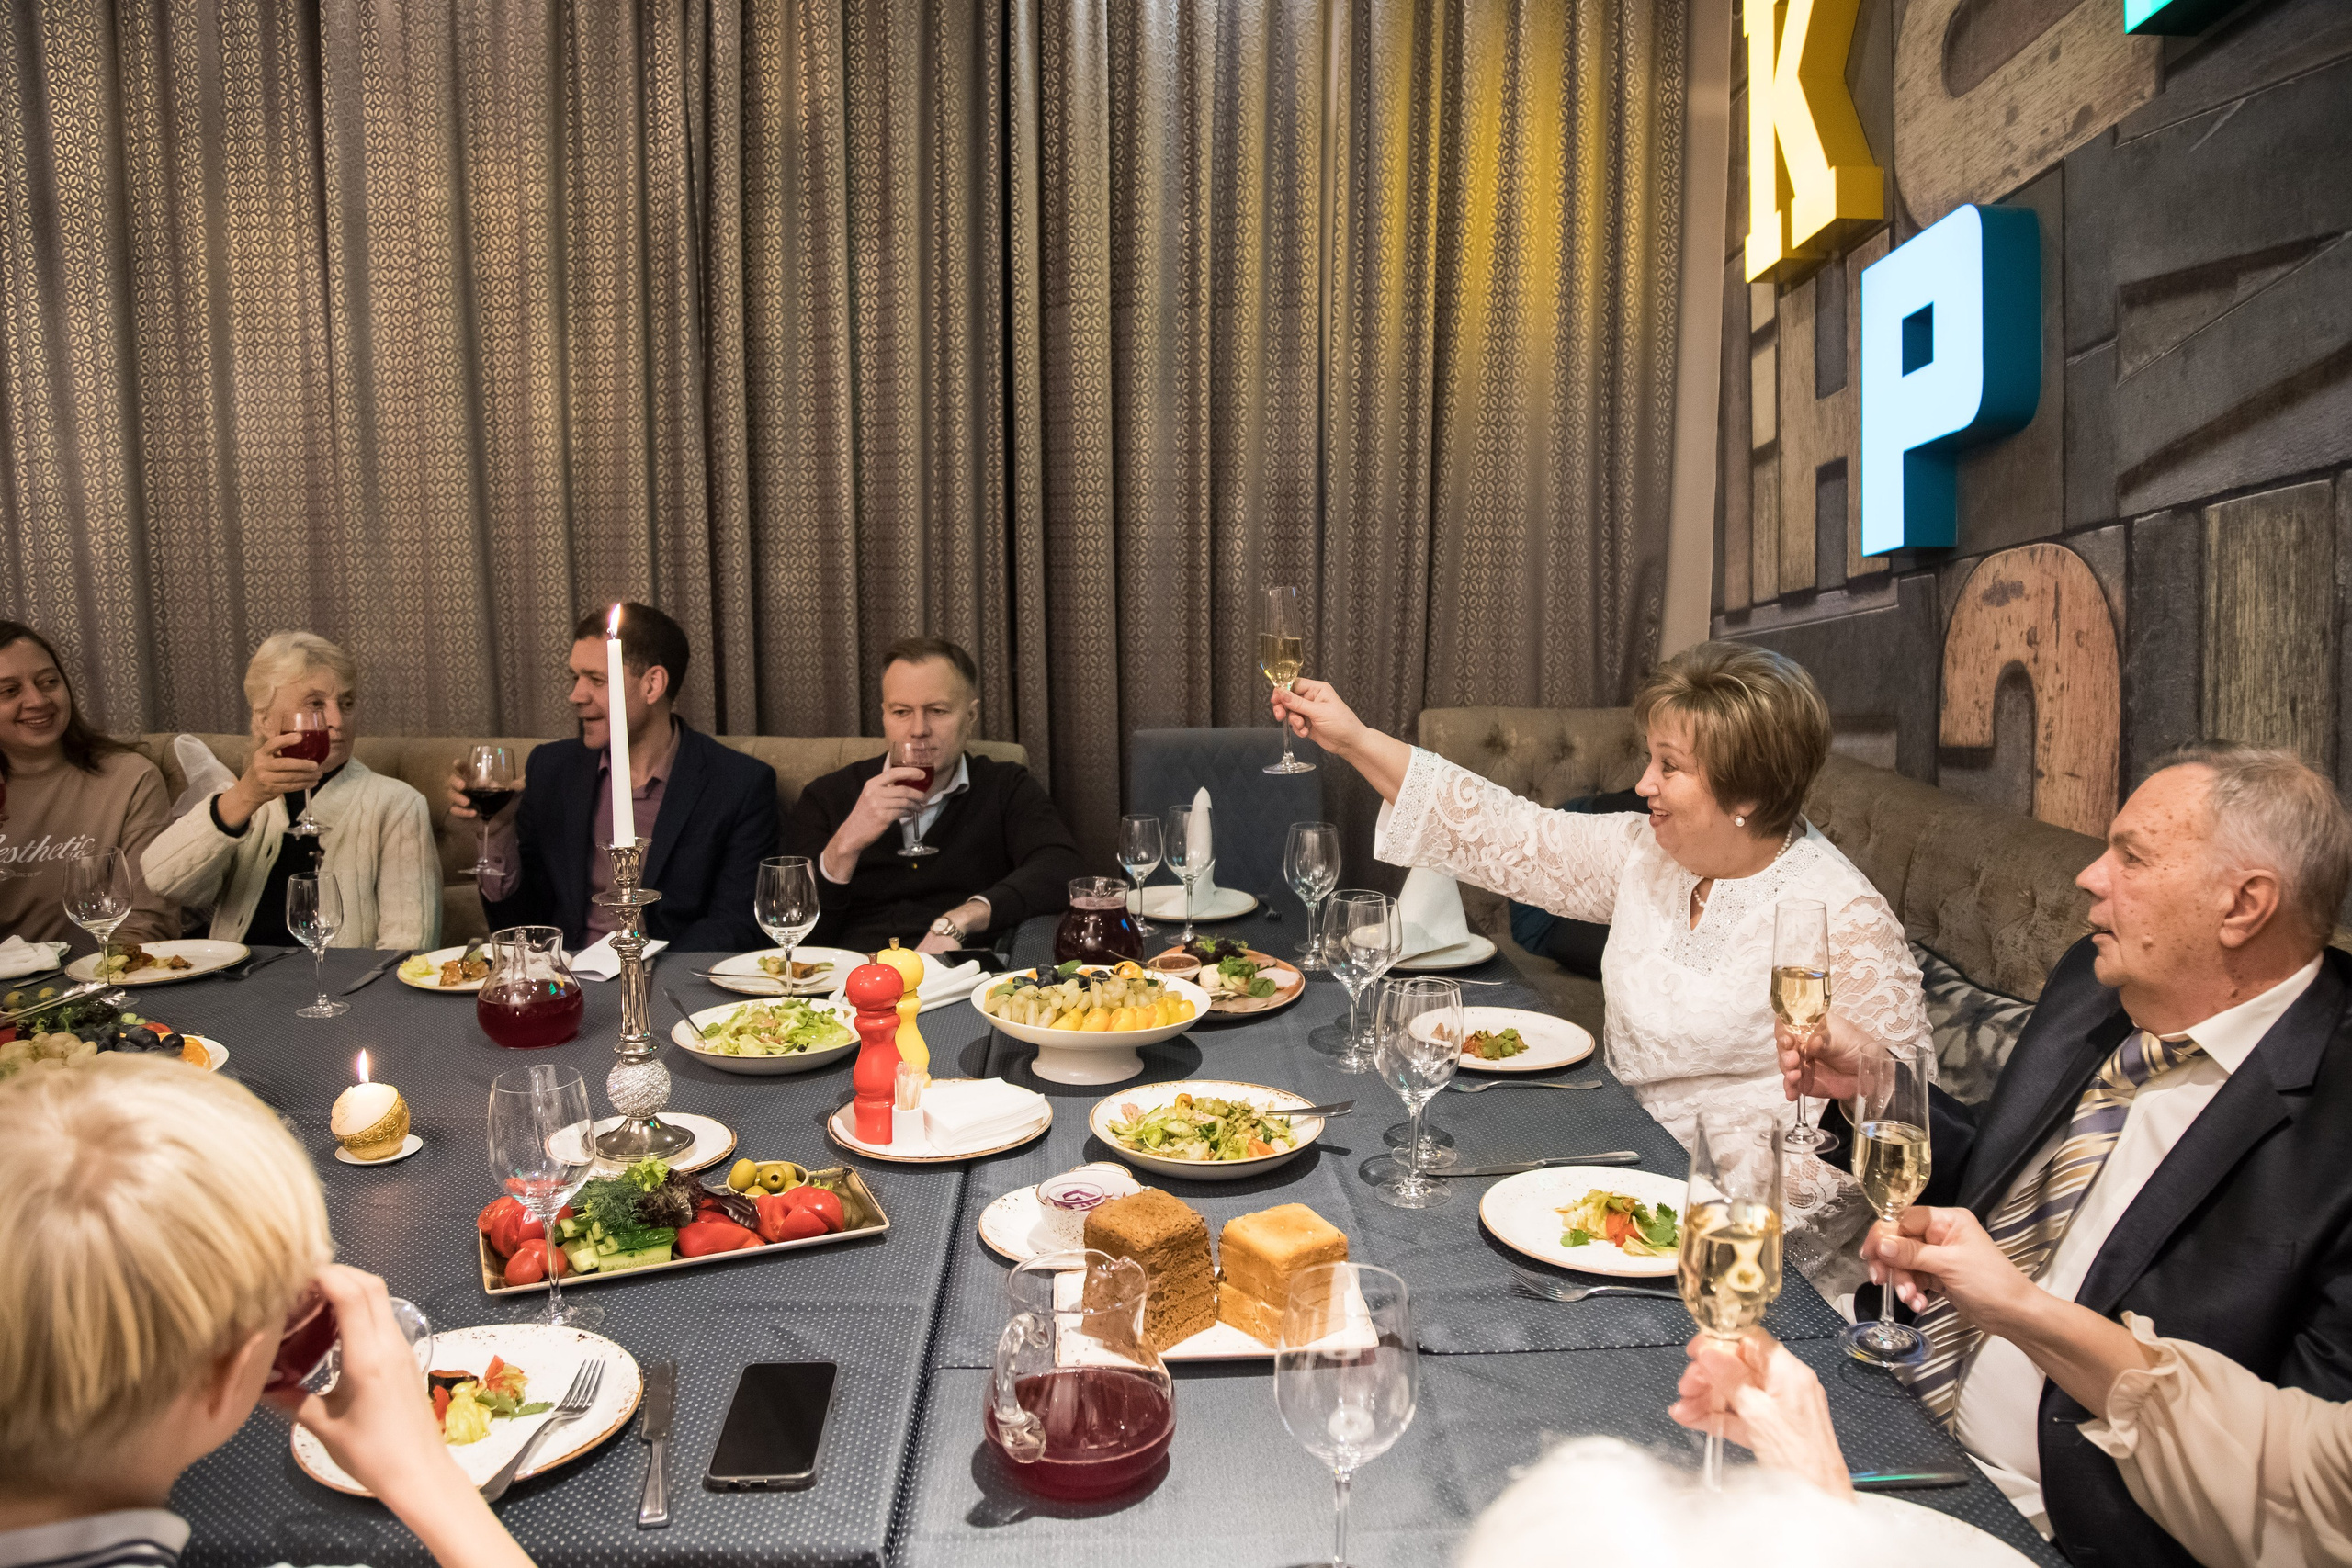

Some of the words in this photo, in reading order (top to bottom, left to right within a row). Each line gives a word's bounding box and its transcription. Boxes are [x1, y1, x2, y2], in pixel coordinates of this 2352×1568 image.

[1743, 0, 1837, 283] K
[1861, 203, 1984, 558] P
[0, 833, 96, 863] esthetic
